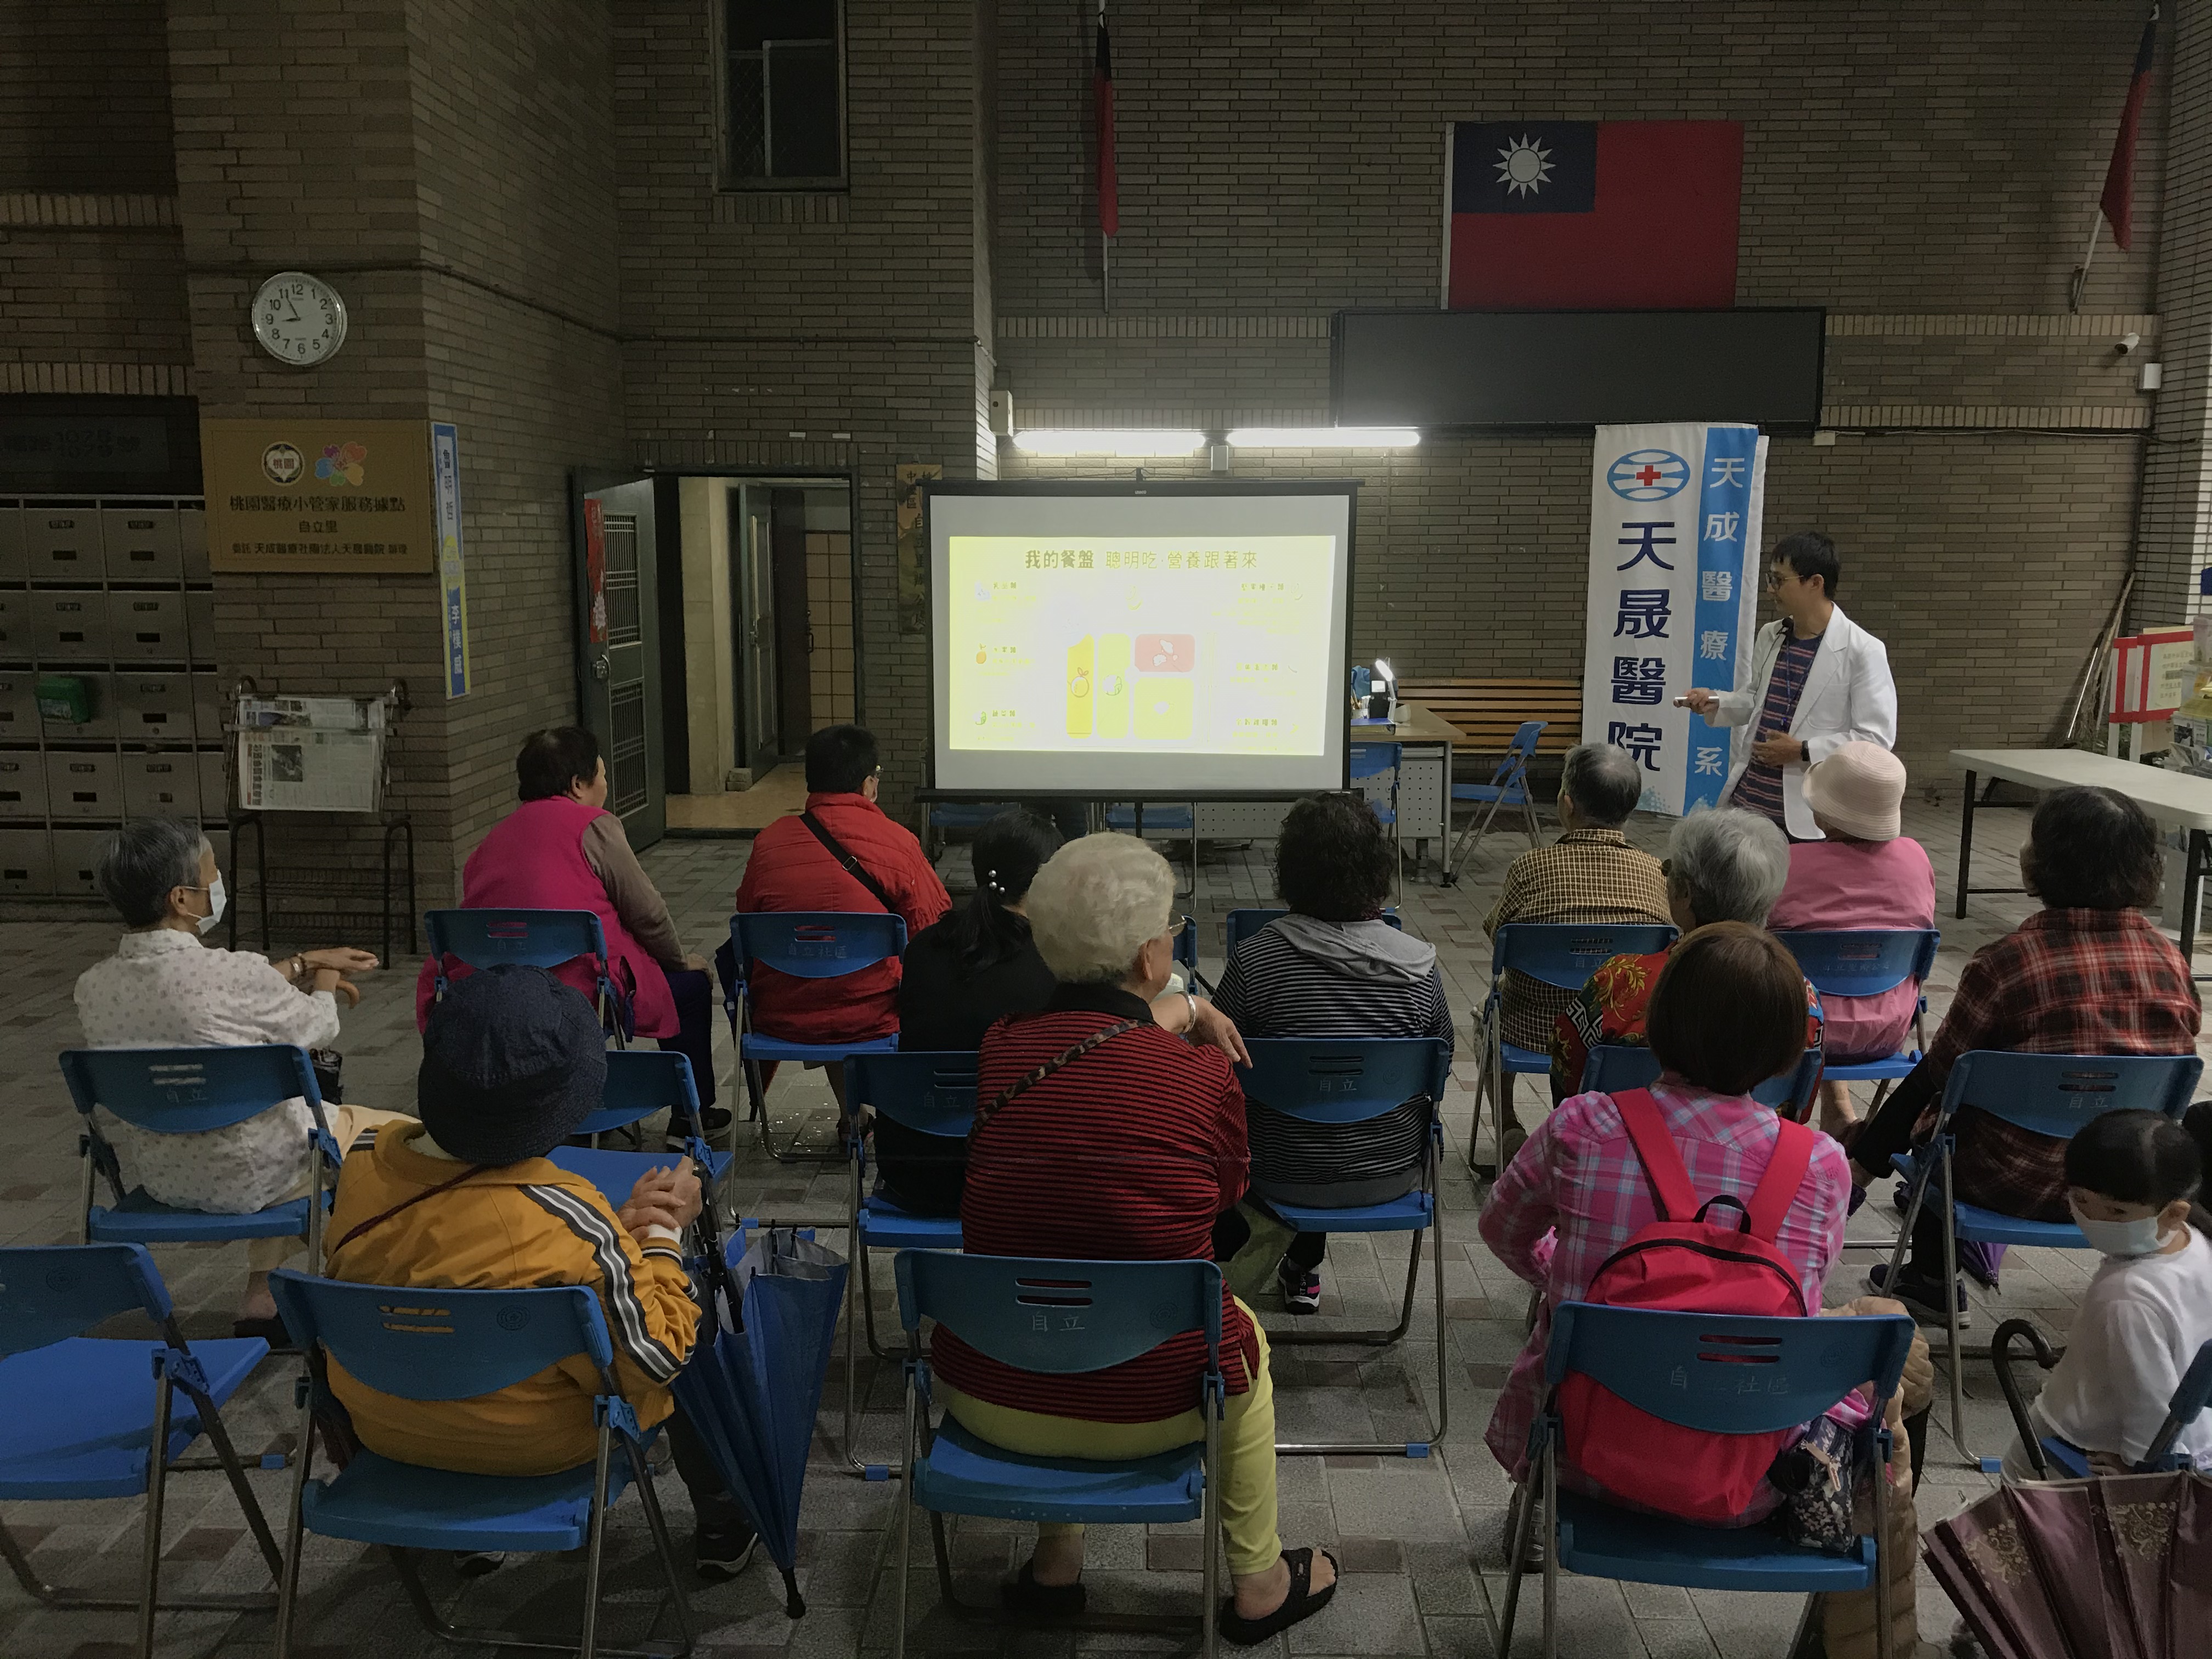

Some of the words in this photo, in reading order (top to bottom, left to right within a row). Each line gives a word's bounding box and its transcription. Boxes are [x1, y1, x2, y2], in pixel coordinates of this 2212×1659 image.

[291, 284, 303, 295] 12
[311, 288, 316, 300] 1
[269, 299, 281, 311] 10
[319, 298, 328, 310] 2
[266, 313, 274, 325] 9
[324, 313, 333, 325] 3
[272, 328, 280, 340] 8
[321, 329, 329, 339] 4
[282, 338, 291, 349] 7
[297, 343, 306, 354] 6
[312, 338, 320, 350] 5
[273, 459, 294, 469] 桃園
[229, 495, 406, 511] 桃園醫療小管家服務據點
[298, 520, 338, 533] 自立里
[1025, 550, 1094, 569] 我的餐盤
[1695, 457, 1746, 777] 天成醫療系
[1607, 521, 1677, 772] 天晟醫院
[1319, 1079, 1357, 1092] 自立
[2069, 1094, 2109, 1109] 自立
[1032, 1312, 1086, 1333] 自立
[1670, 1364, 1788, 1395] 自社區
